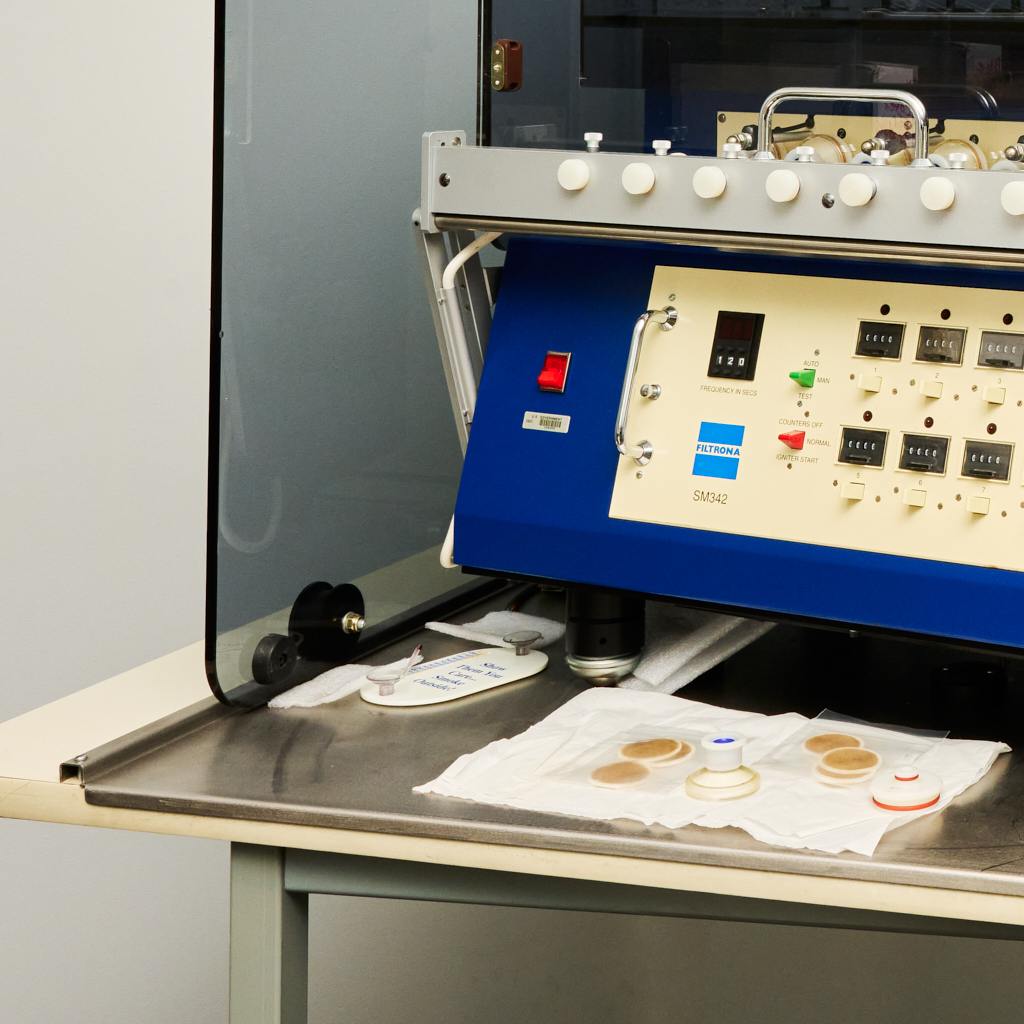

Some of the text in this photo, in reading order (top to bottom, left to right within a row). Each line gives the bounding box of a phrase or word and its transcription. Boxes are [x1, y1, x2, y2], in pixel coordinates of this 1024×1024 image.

[716, 355, 745, 366] 120
[700, 385, 734, 394] FREQUENCY
[779, 419, 811, 427] COUNTERS
[806, 439, 831, 447] NORMAL
[696, 444, 740, 456] FILTRONA
[776, 454, 799, 462] IGNITER
[692, 489, 728, 504] SM342
[480, 662, 507, 671] Show
[484, 671, 504, 679] You
[431, 675, 466, 685] Smoke
